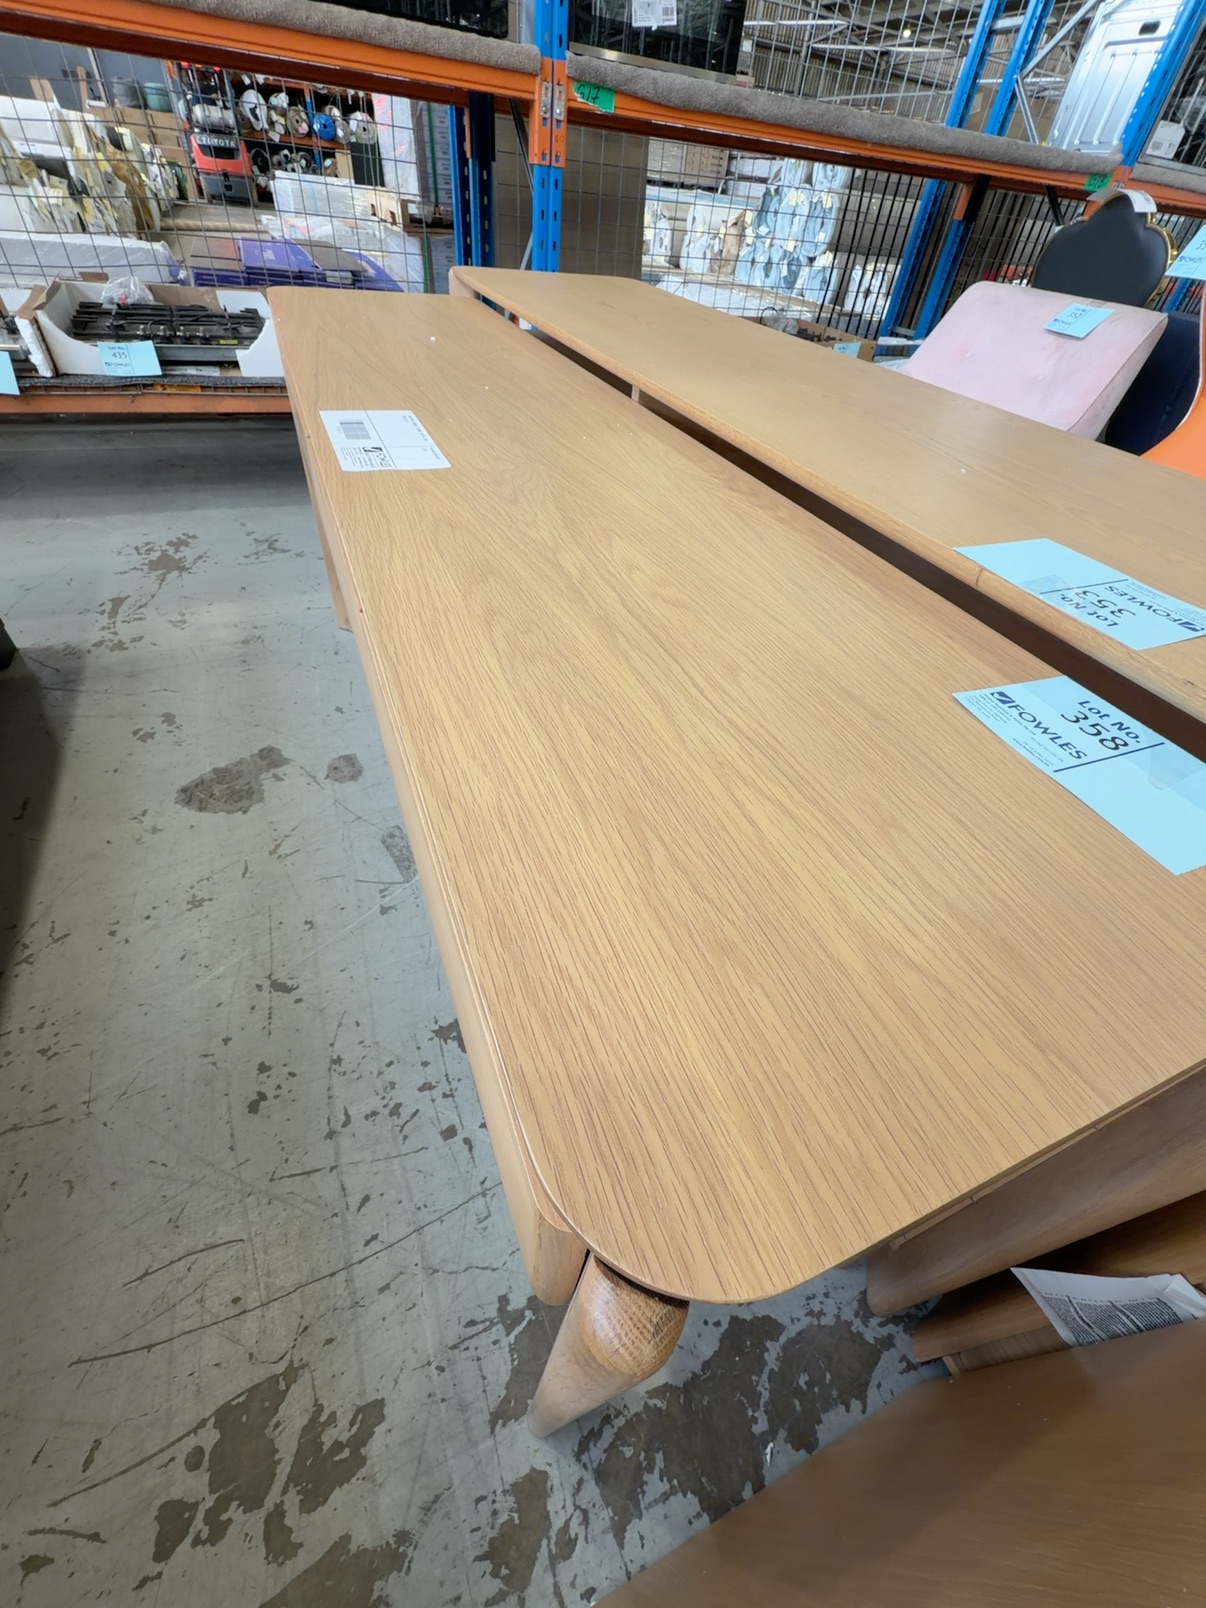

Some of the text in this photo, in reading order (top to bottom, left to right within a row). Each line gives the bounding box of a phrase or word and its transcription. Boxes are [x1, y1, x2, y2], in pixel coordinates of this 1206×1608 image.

[201, 136, 237, 148] TOYOTA
[112, 351, 127, 359] 435
[1060, 593, 1119, 627] Lot No.
[1075, 590, 1136, 618] 353
[1104, 585, 1183, 623] FOWLES
[1007, 704, 1087, 760] FOWLES
[1060, 710, 1130, 751] 358
[1078, 700, 1141, 743] Lot No.
